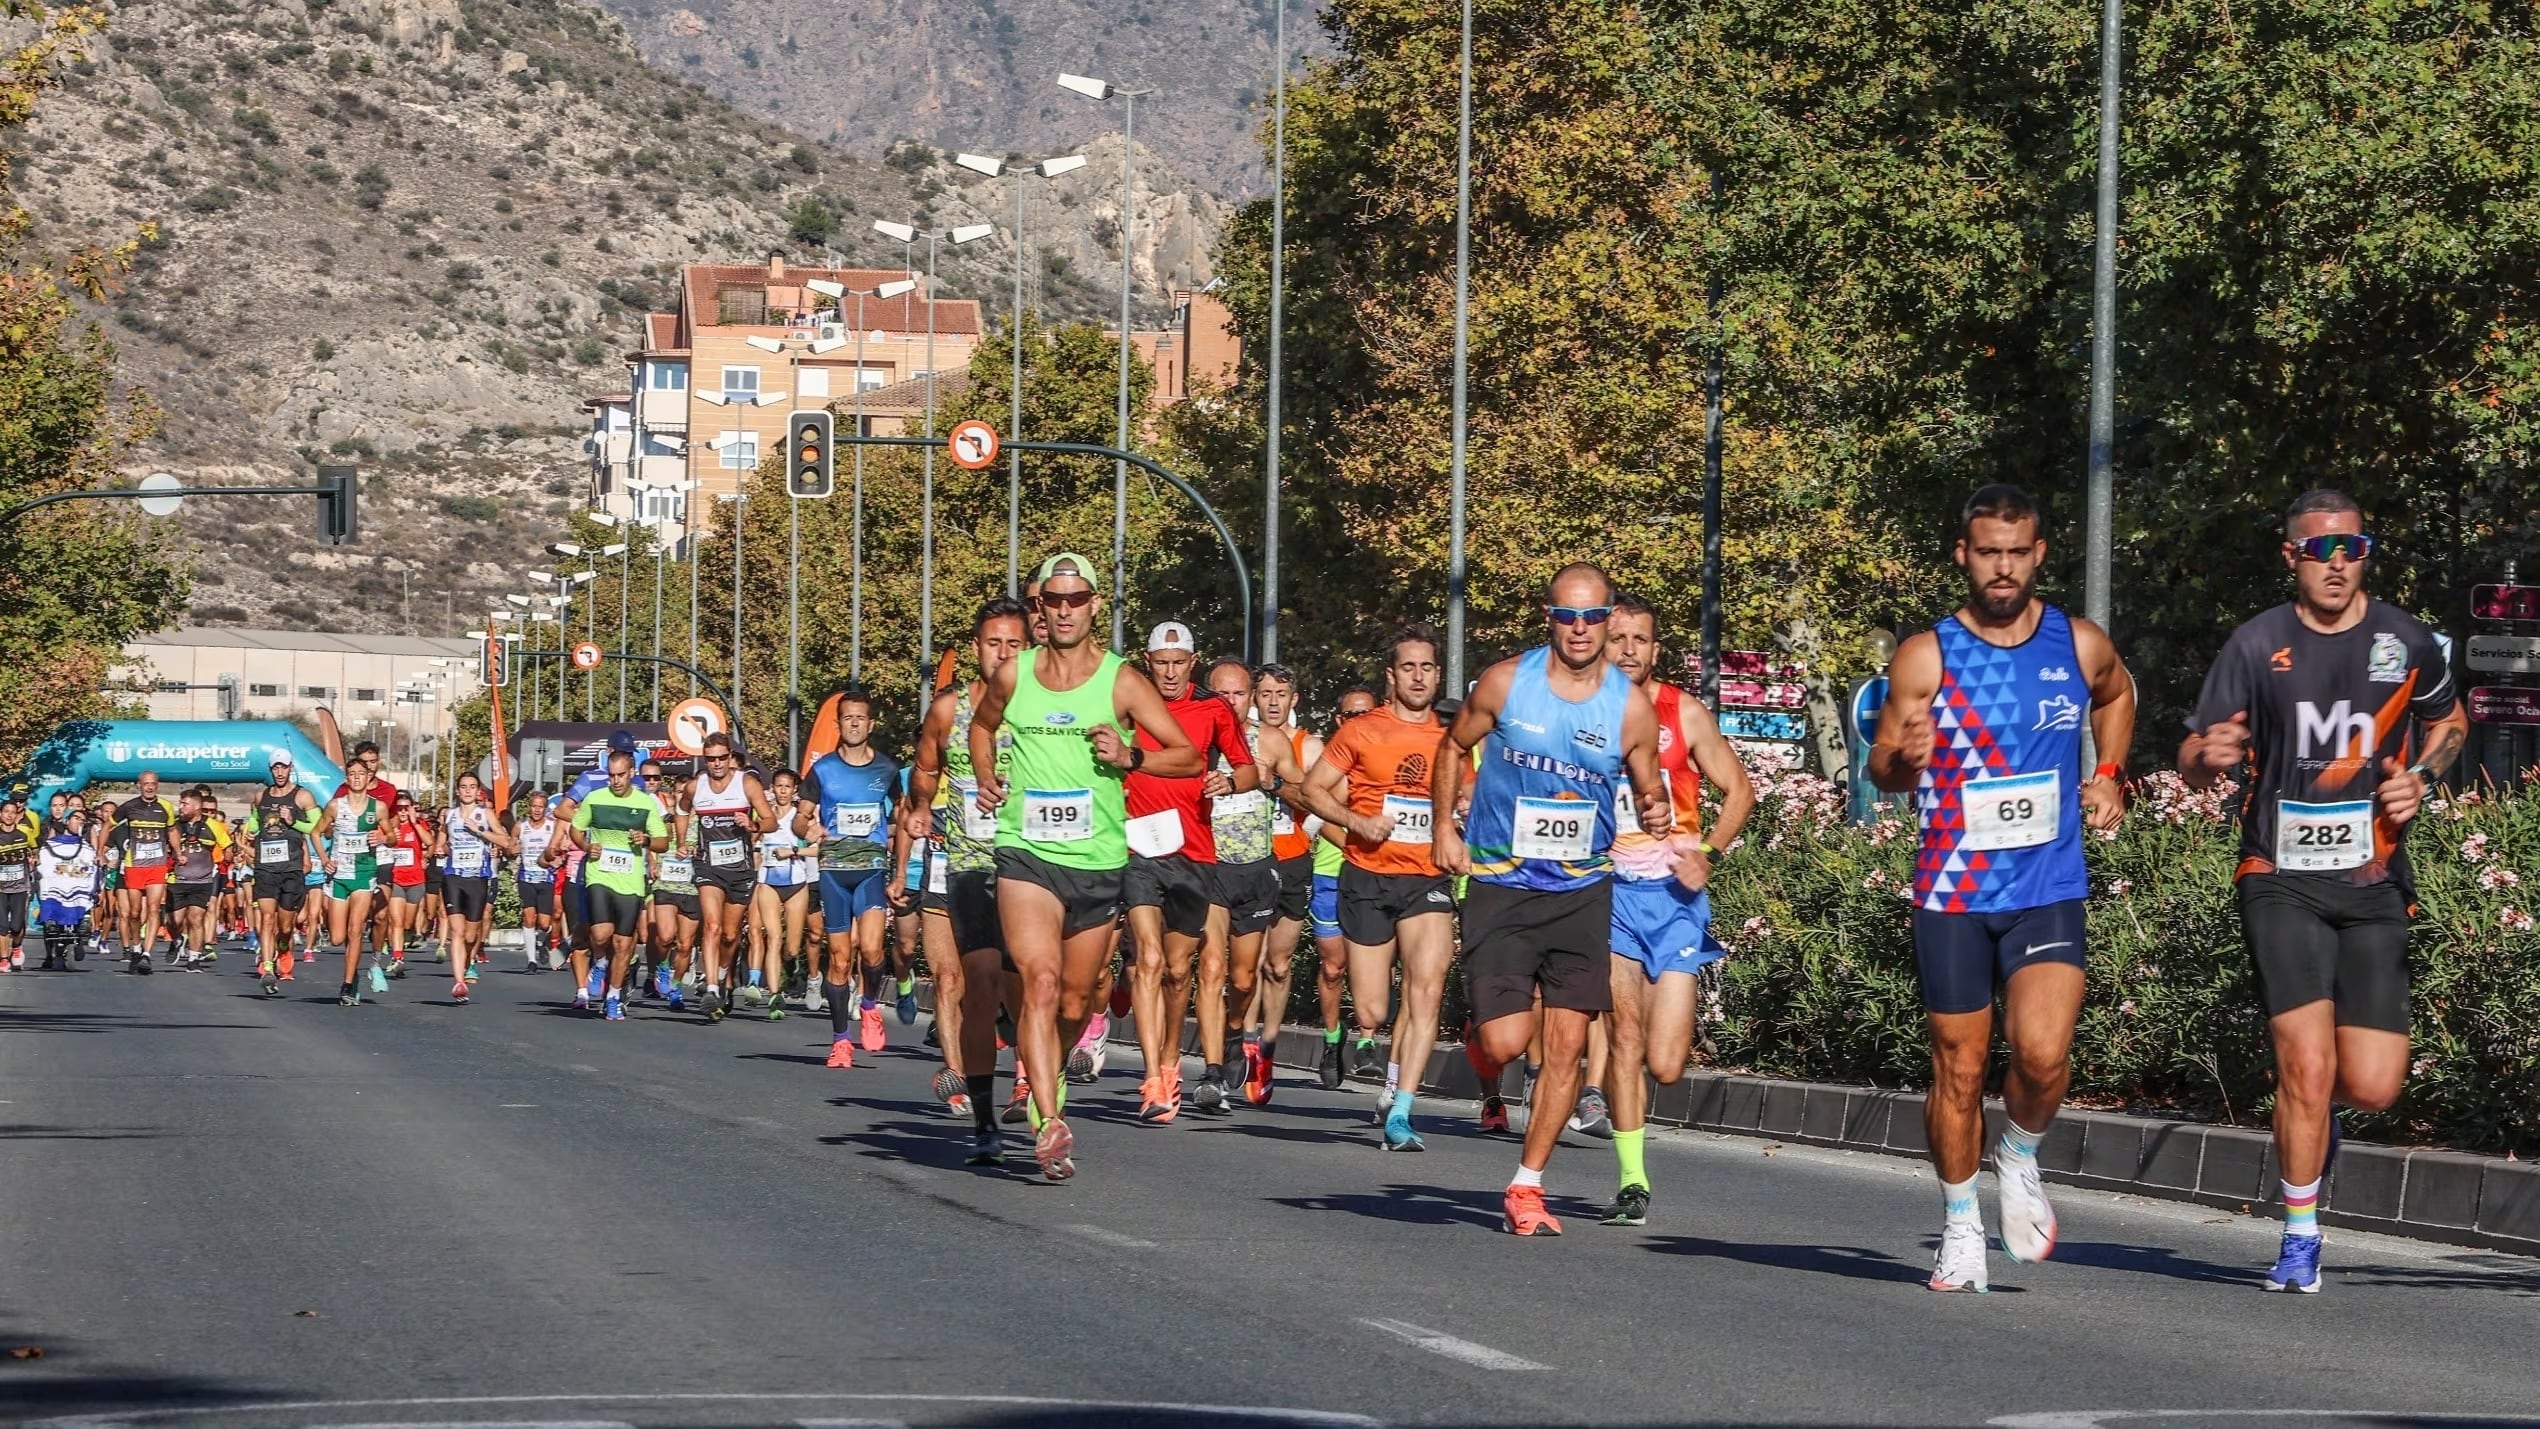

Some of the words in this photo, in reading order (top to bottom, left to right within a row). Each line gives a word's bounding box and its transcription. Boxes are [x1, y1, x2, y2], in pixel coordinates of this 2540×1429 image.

[2471, 647, 2522, 659] Servicios
[2505, 696, 2530, 704] social
[2474, 703, 2513, 714] Severo
[136, 742, 251, 763] caixapetrer
[210, 760, 229, 768] Obra
[230, 760, 250, 768] Social
[1038, 806, 1078, 822] 199
[1998, 798, 2033, 821] 69
[847, 814, 872, 824] 348
[1397, 811, 1429, 827] 210
[1535, 818, 1579, 838] 209
[2298, 823, 2352, 846] 282
[345, 837, 362, 847] 261
[266, 847, 282, 855] 106
[458, 852, 476, 860] 227
[718, 846, 738, 857] 103
[608, 855, 627, 865] 161
[668, 864, 687, 874] 345
